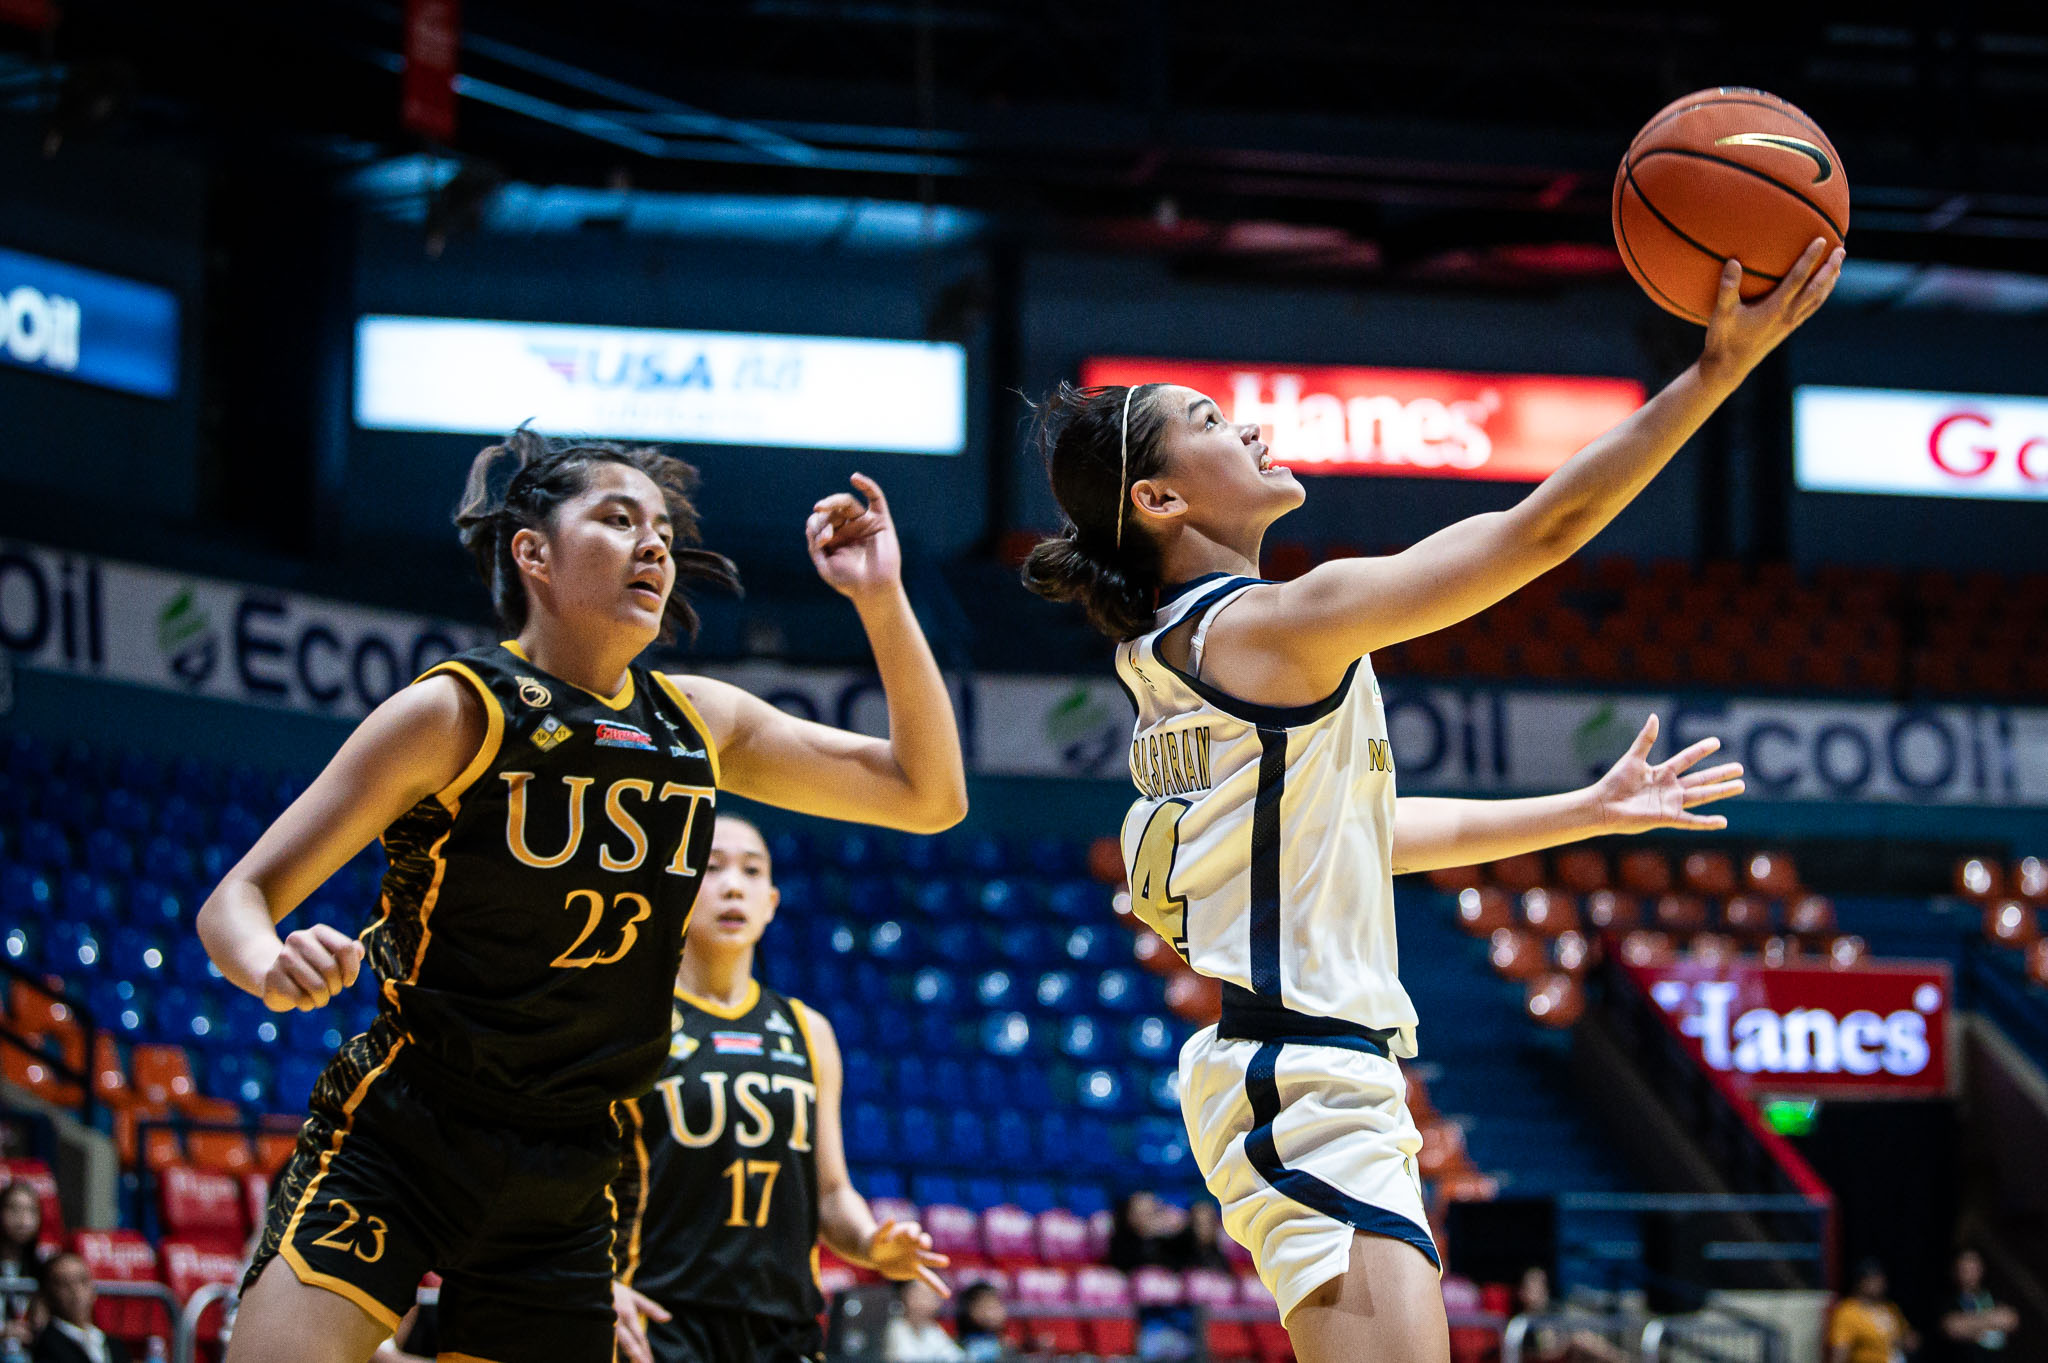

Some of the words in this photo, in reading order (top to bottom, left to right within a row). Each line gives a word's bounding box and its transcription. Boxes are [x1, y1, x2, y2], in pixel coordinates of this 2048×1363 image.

[0, 285, 80, 373] Oil
[587, 346, 715, 392] USA
[1231, 371, 1492, 470] Hanes
[499, 771, 716, 877] UST
[1131, 797, 1194, 965] 4
[549, 889, 652, 969] 23
[653, 1071, 817, 1153] UST
[311, 1198, 389, 1263] 23
[722, 1157, 782, 1228] 17
